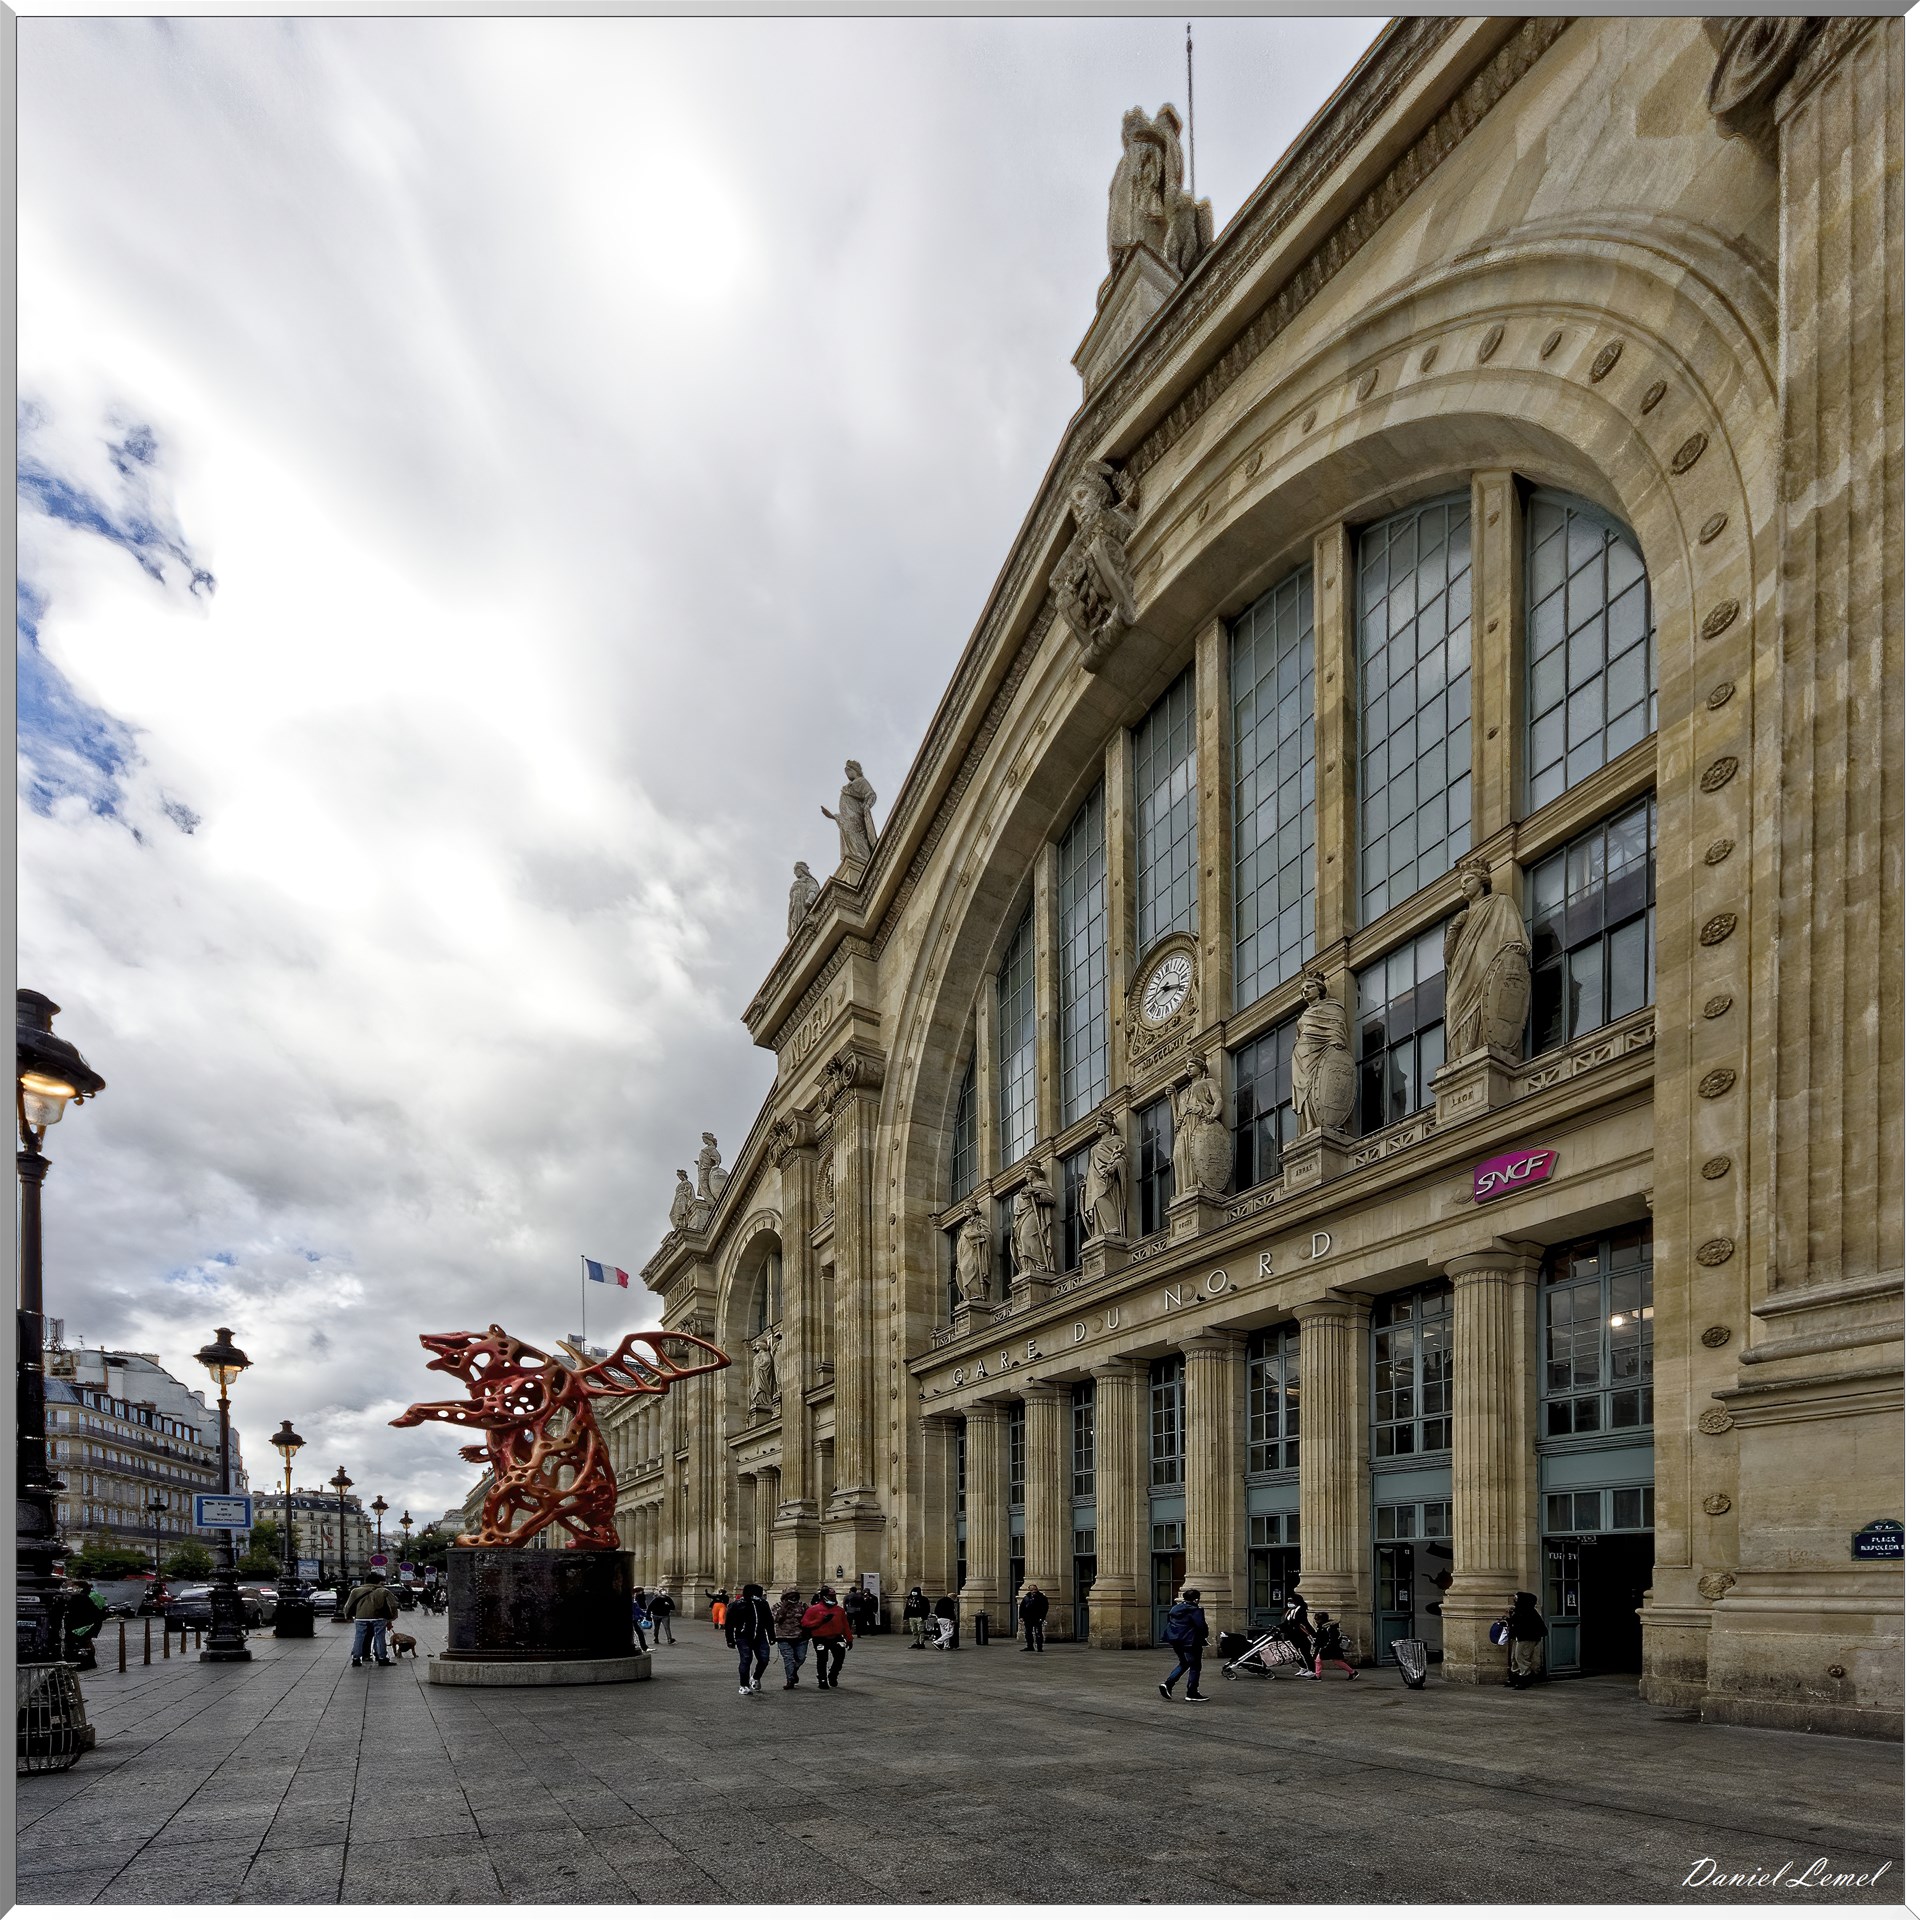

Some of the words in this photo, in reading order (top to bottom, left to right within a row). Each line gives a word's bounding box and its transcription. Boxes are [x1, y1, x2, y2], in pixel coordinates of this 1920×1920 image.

[791, 994, 834, 1070] NORD
[1475, 1152, 1549, 1195] SNCF
[952, 1339, 1038, 1386] GARE
[1074, 1307, 1119, 1342] DU
[1164, 1231, 1332, 1311] NORD
